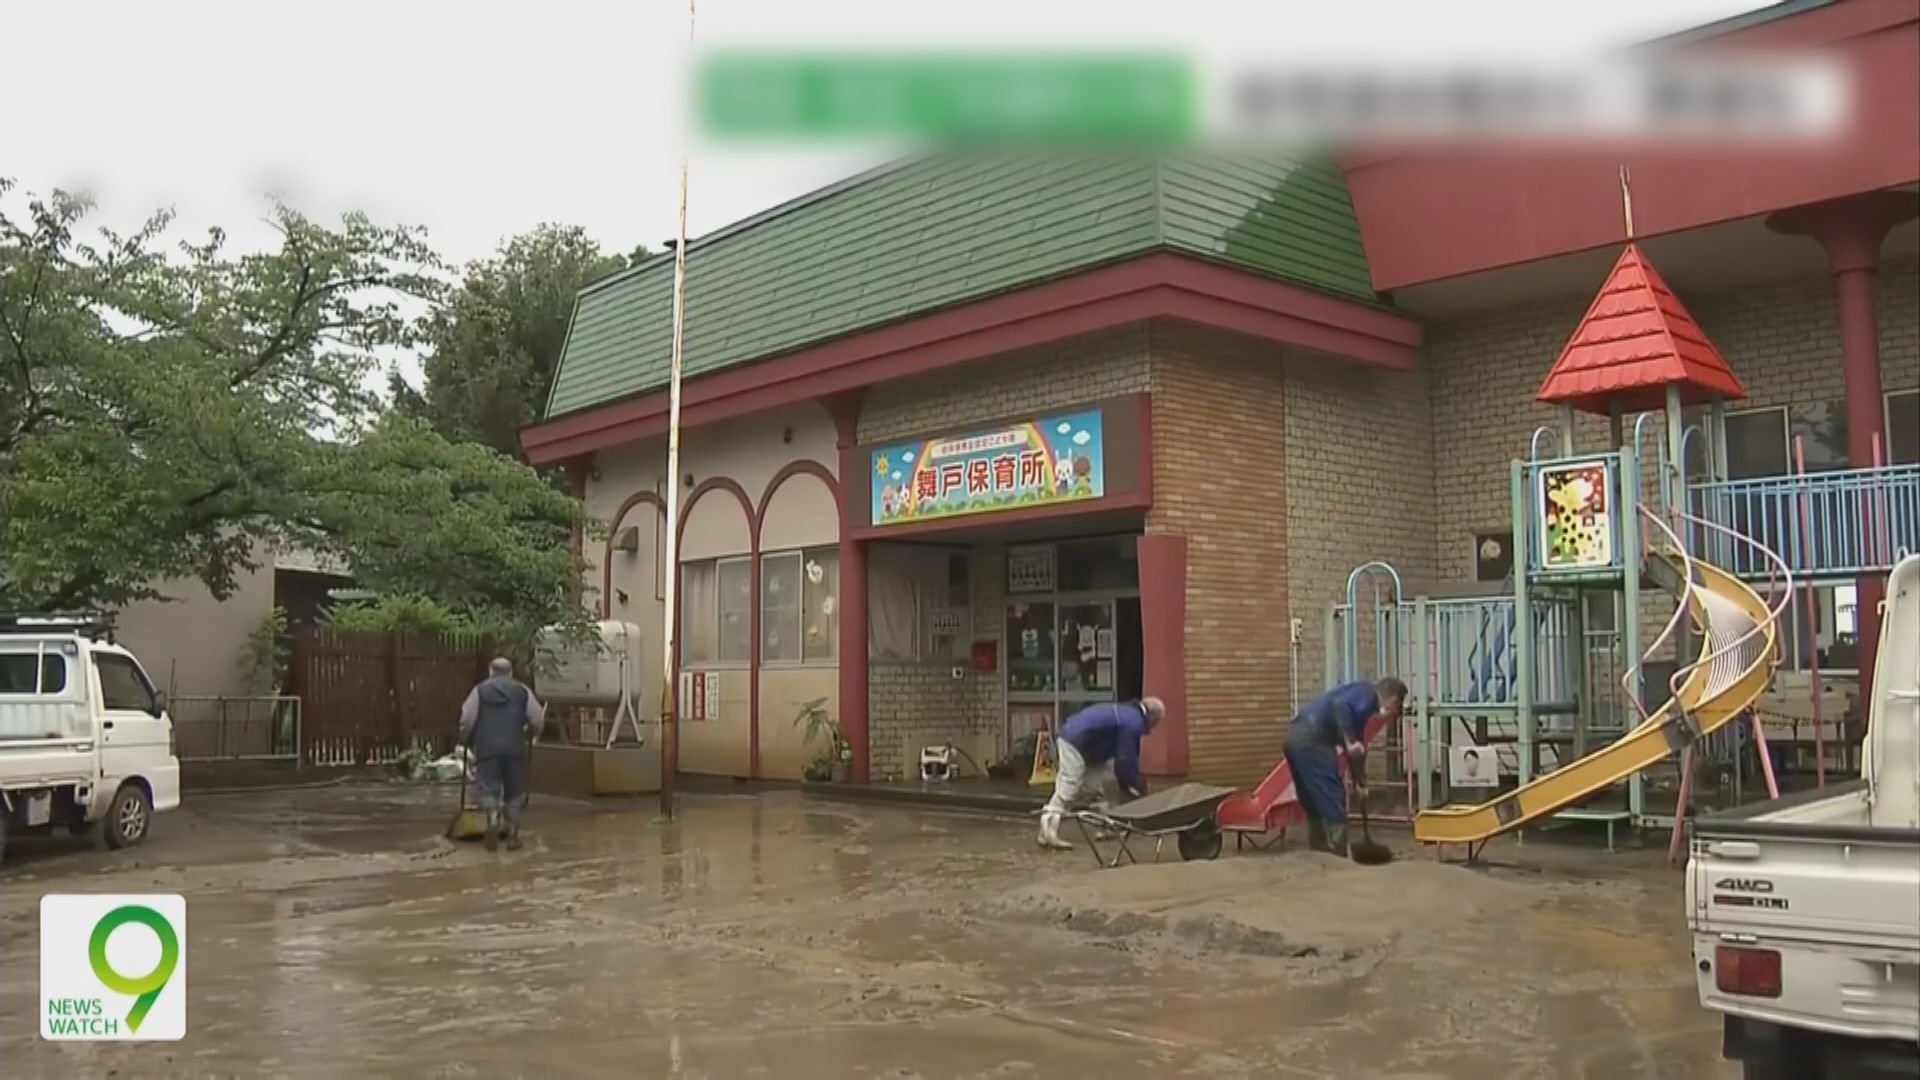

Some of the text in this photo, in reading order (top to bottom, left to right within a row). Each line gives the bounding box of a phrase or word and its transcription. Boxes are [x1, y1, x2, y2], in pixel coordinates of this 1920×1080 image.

[917, 451, 1045, 500] 舞戸保育所
[1715, 878, 1773, 893] 4WD
